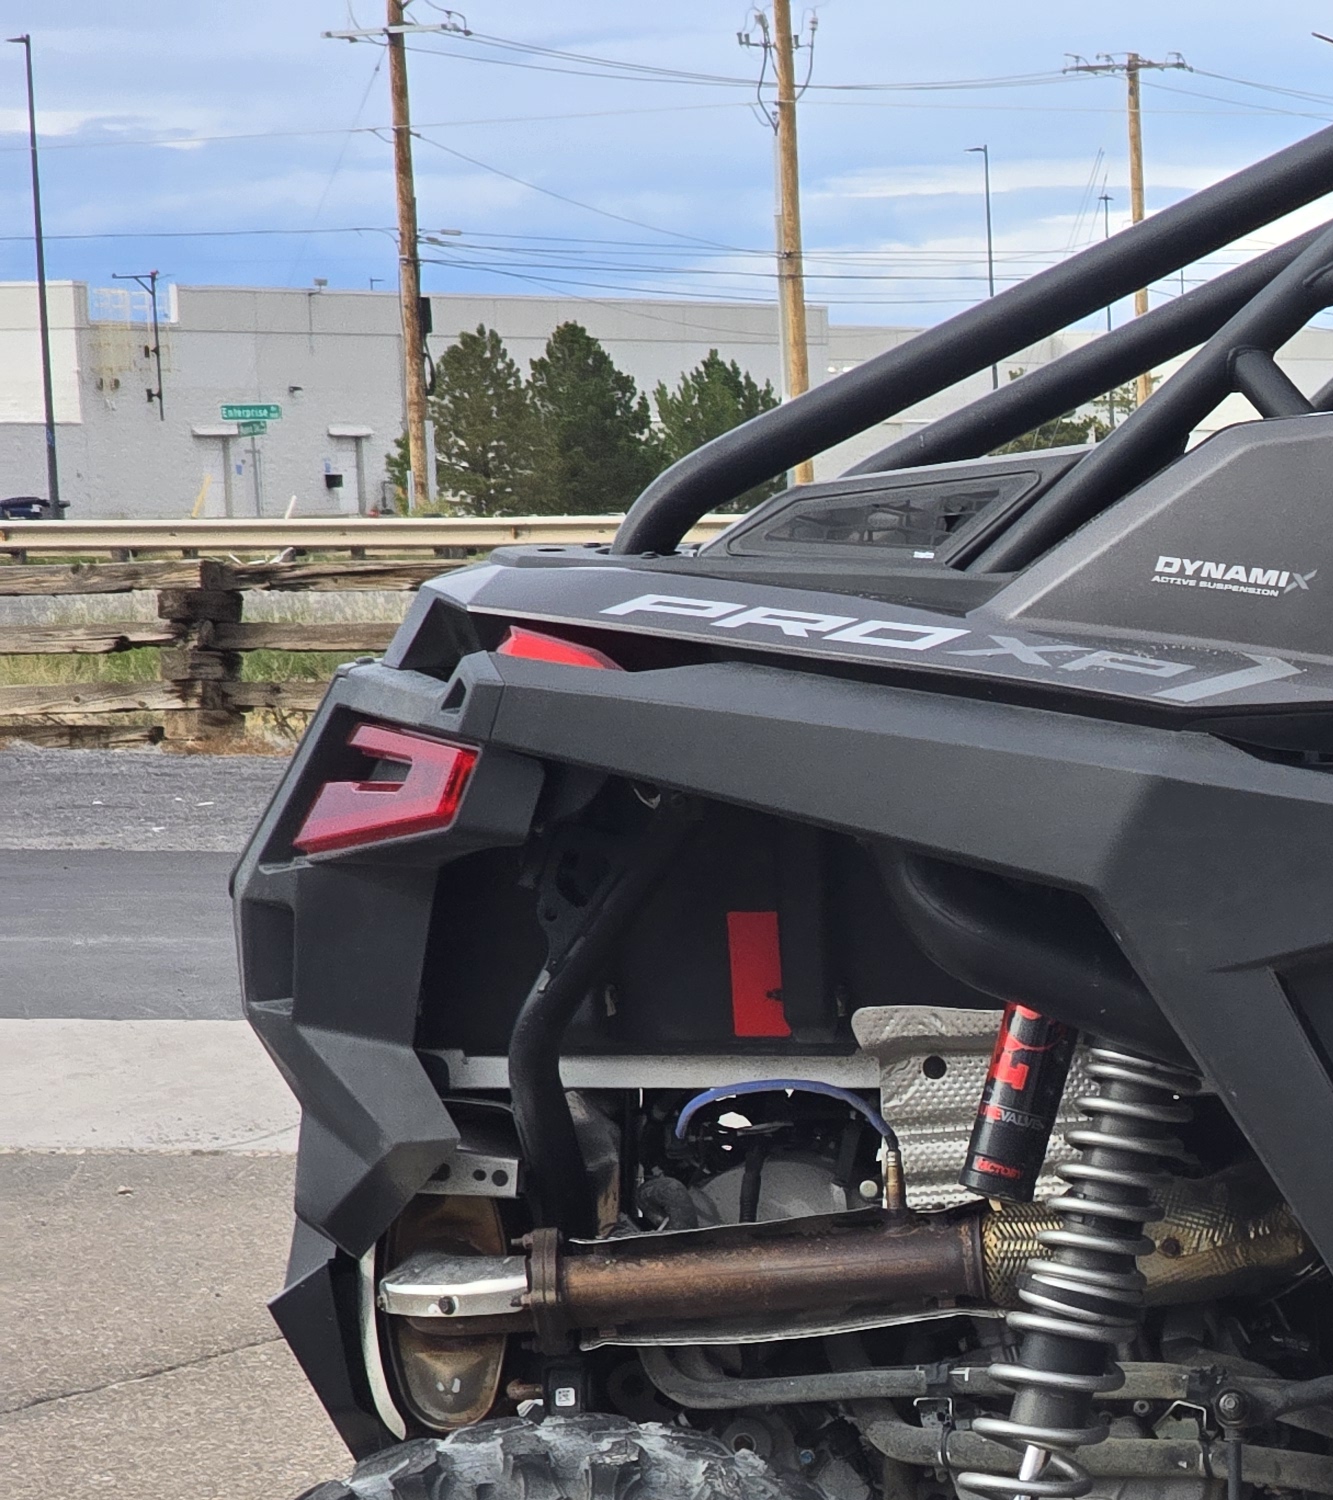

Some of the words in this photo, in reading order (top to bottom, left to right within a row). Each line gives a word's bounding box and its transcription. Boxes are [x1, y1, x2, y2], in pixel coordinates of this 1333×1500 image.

[221, 407, 268, 418] Enterprise
[1151, 575, 1197, 587] ACTIVE
[1199, 580, 1279, 597] SUSPENSION
[1153, 555, 1318, 594] DYNAMIX
[600, 594, 972, 651] PRO
